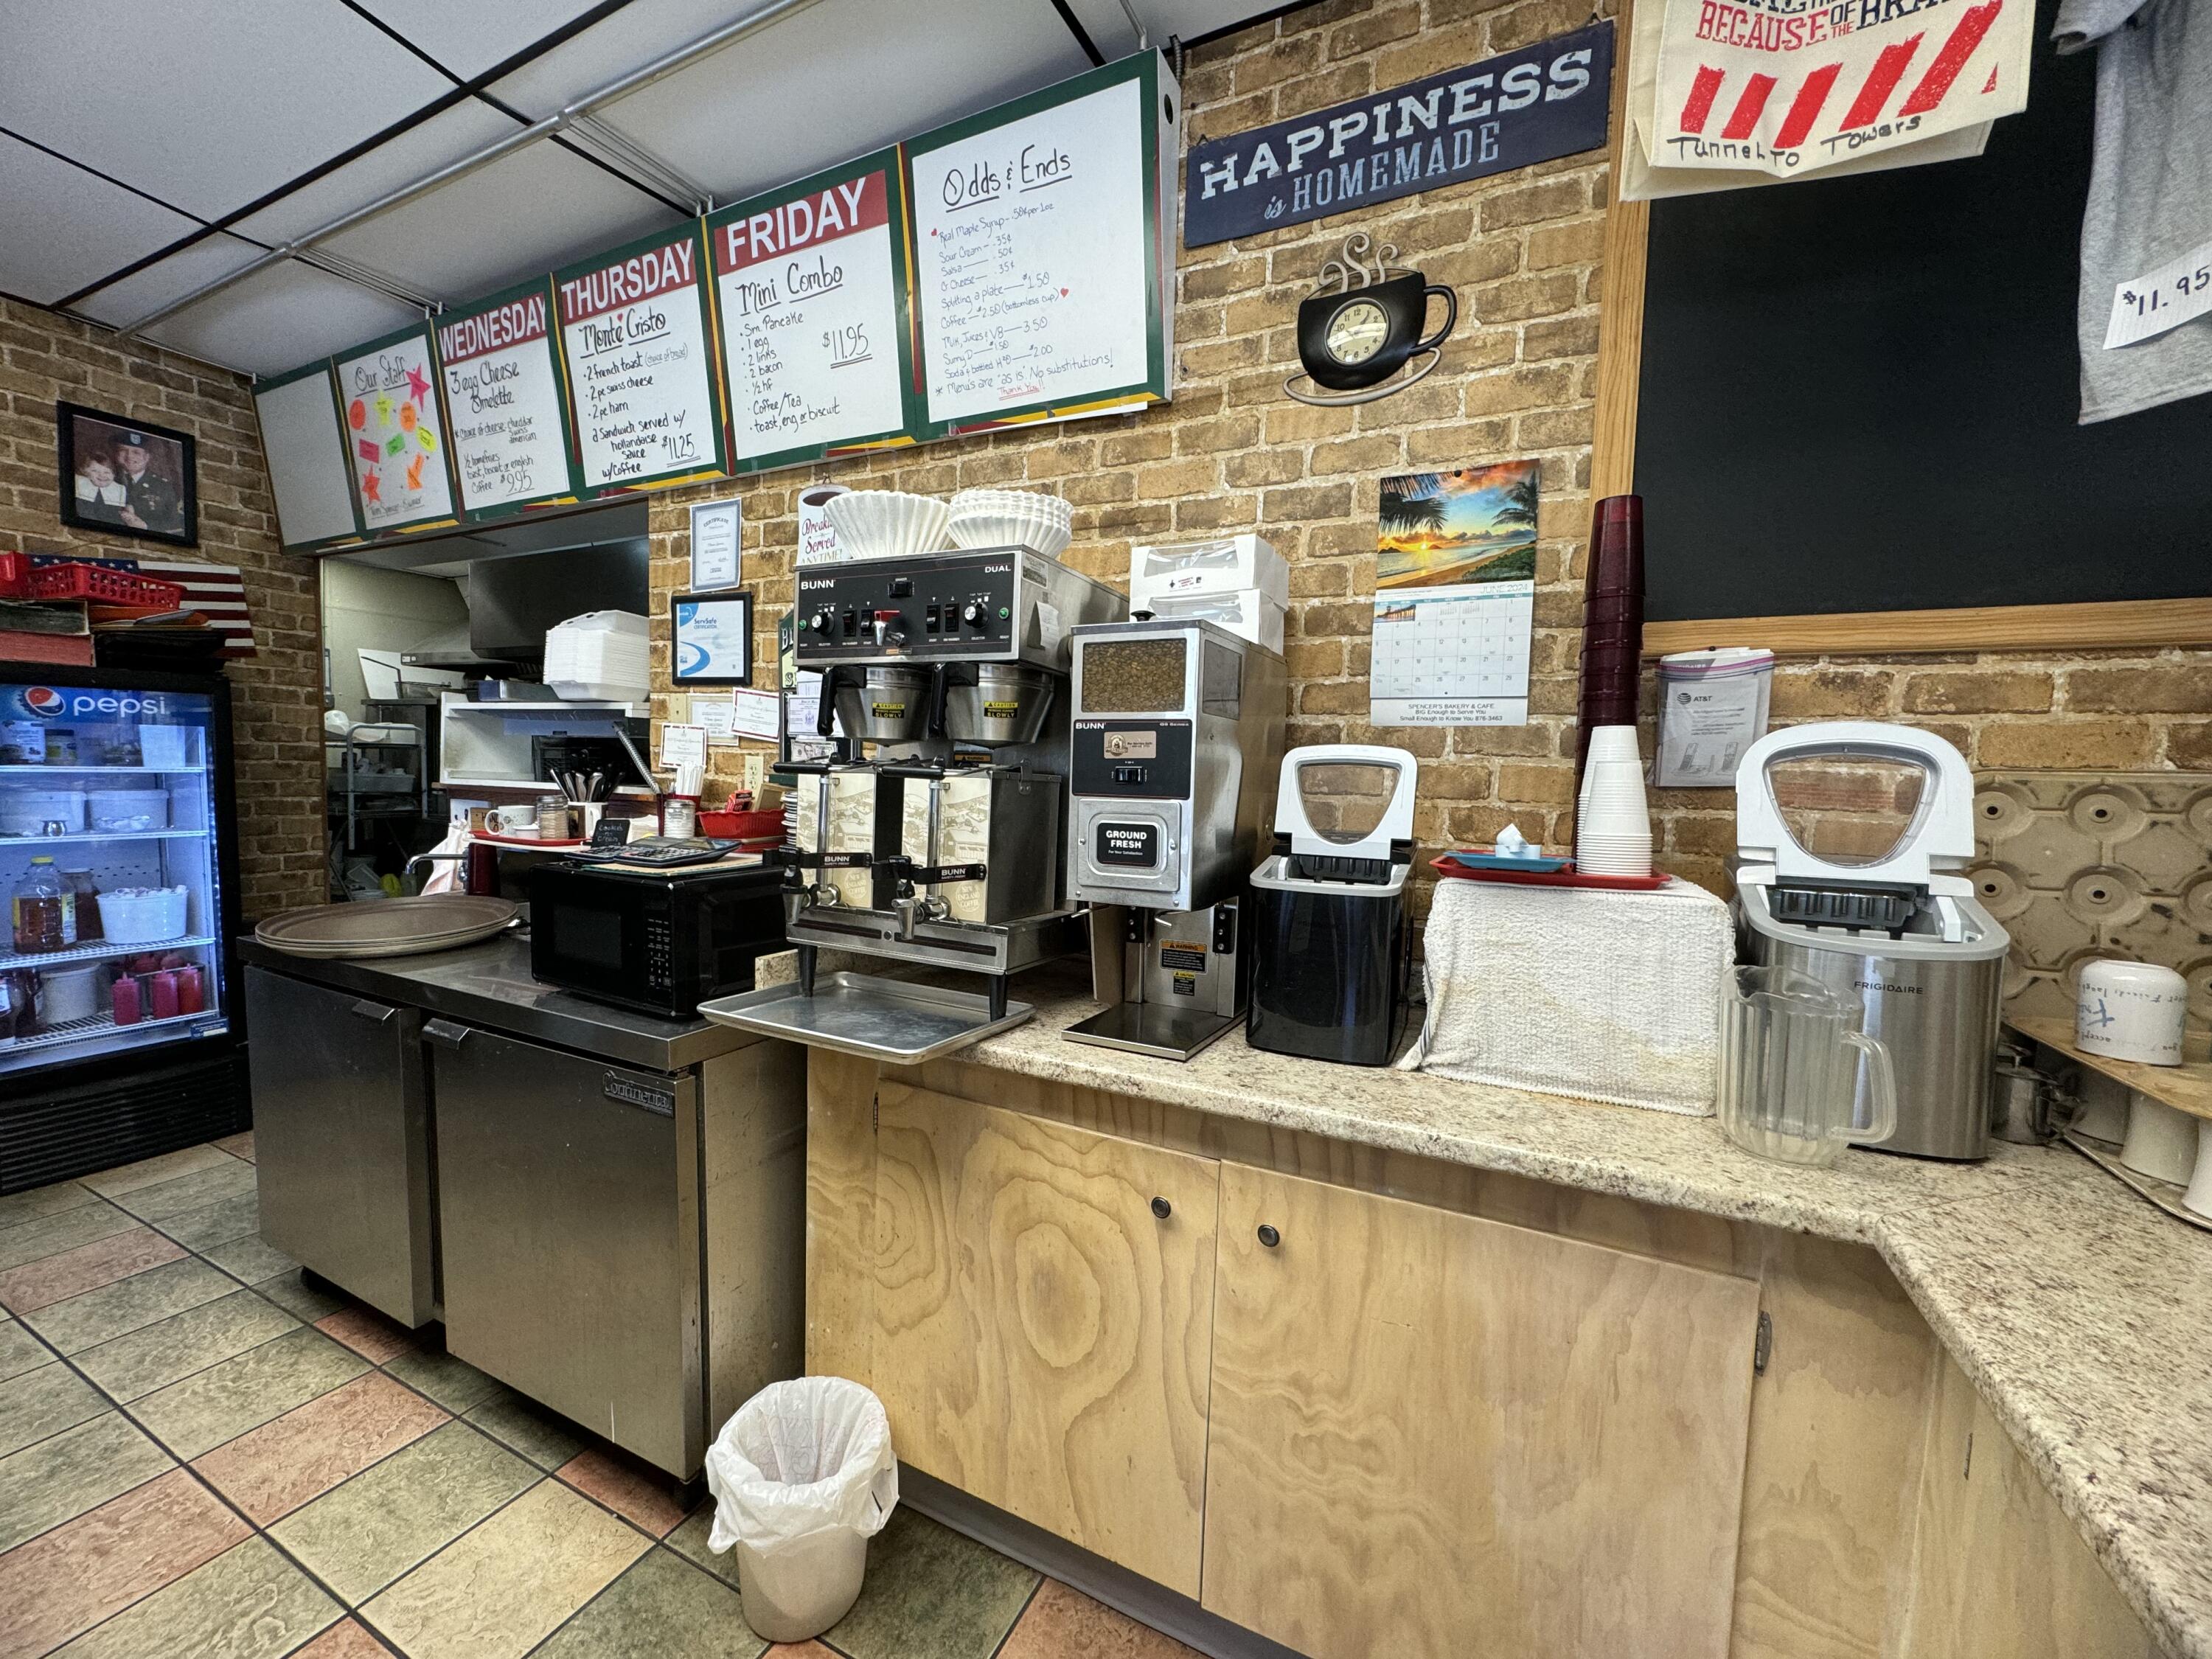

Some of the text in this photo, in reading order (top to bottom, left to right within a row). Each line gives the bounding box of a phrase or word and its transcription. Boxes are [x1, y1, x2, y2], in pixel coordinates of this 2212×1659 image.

[1830, 1, 1856, 26] OF
[1695, 0, 1829, 52] BECAUSE
[1830, 21, 1854, 39] THE
[1200, 48, 1593, 201] HAPPINESS
[1820, 114, 1922, 156] Towers
[943, 161, 1001, 206] Odds
[1021, 144, 1071, 184] Ends
[1264, 119, 1500, 220] is HOMEMADE
[726, 177, 867, 267] FRIDAY
[938, 228, 954, 248] Real
[956, 222, 980, 237] Maple
[978, 217, 1005, 239] Syrup
[939, 251, 957, 264] Sour
[959, 246, 983, 259] Cream
[560, 237, 693, 319] THURSDAY
[941, 265, 963, 277] Salsa
[734, 255, 844, 315] Mini Combo
[950, 276, 975, 290] Cheese
[940, 314, 967, 330] Coffee
[1001, 296, 1040, 316] (bottomless
[1041, 288, 1060, 303] cup)
[941, 295, 973, 315] Splitting
[974, 291, 981, 301] a
[981, 283, 1004, 303] plate
[438, 296, 547, 363] WEDNESDAY
[578, 305, 667, 355] Monte Cristo
[762, 312, 804, 330] Pancake
[754, 336, 770, 353] egg
[822, 322, 869, 361] $11.95
[961, 331, 984, 344] Juices
[989, 325, 1005, 341] V8
[748, 349, 777, 366] 2 links
[964, 349, 974, 360] D
[355, 355, 406, 392] Our Staff
[586, 366, 594, 381] 2
[594, 361, 620, 380] french
[621, 350, 644, 372] toast
[750, 361, 783, 379] 2 bacon
[944, 368, 965, 379] Soda
[970, 360, 994, 374] bottled
[978, 377, 994, 389] are
[1029, 365, 1044, 381] No
[1046, 347, 1114, 376] substitutions!
[450, 360, 520, 397] 3 egg Cheese
[590, 385, 598, 401] 2
[607, 381, 626, 394] swiss
[627, 375, 654, 389] cheese
[470, 385, 515, 414] Omelette
[997, 384, 1023, 397] Thank
[592, 404, 599, 420] 2
[608, 400, 629, 413] ham
[782, 414, 799, 434] eng
[799, 413, 807, 422] or
[807, 396, 841, 420] biscuit
[507, 416, 533, 429] cheddar
[508, 426, 529, 437] swiss
[638, 412, 669, 432] served
[508, 431, 538, 444] american
[611, 433, 658, 453] hollandaise
[661, 432, 695, 460] $11.25
[510, 453, 535, 472] english
[622, 448, 647, 461] sauce
[471, 479, 493, 495] Coffee
[804, 529, 836, 554] Served
[984, 565, 1012, 574] DUAL
[801, 579, 835, 590] BUNN
[1481, 583, 1530, 594] JUNE 2024
[694, 616, 717, 625] ServSafe
[73, 695, 167, 718] pepsi
[1106, 830, 1147, 840] GROUND
[1110, 839, 1142, 849] FRESH
[941, 868, 967, 876] BUNN
[1854, 981, 1924, 995] FRIGIDAIRE
